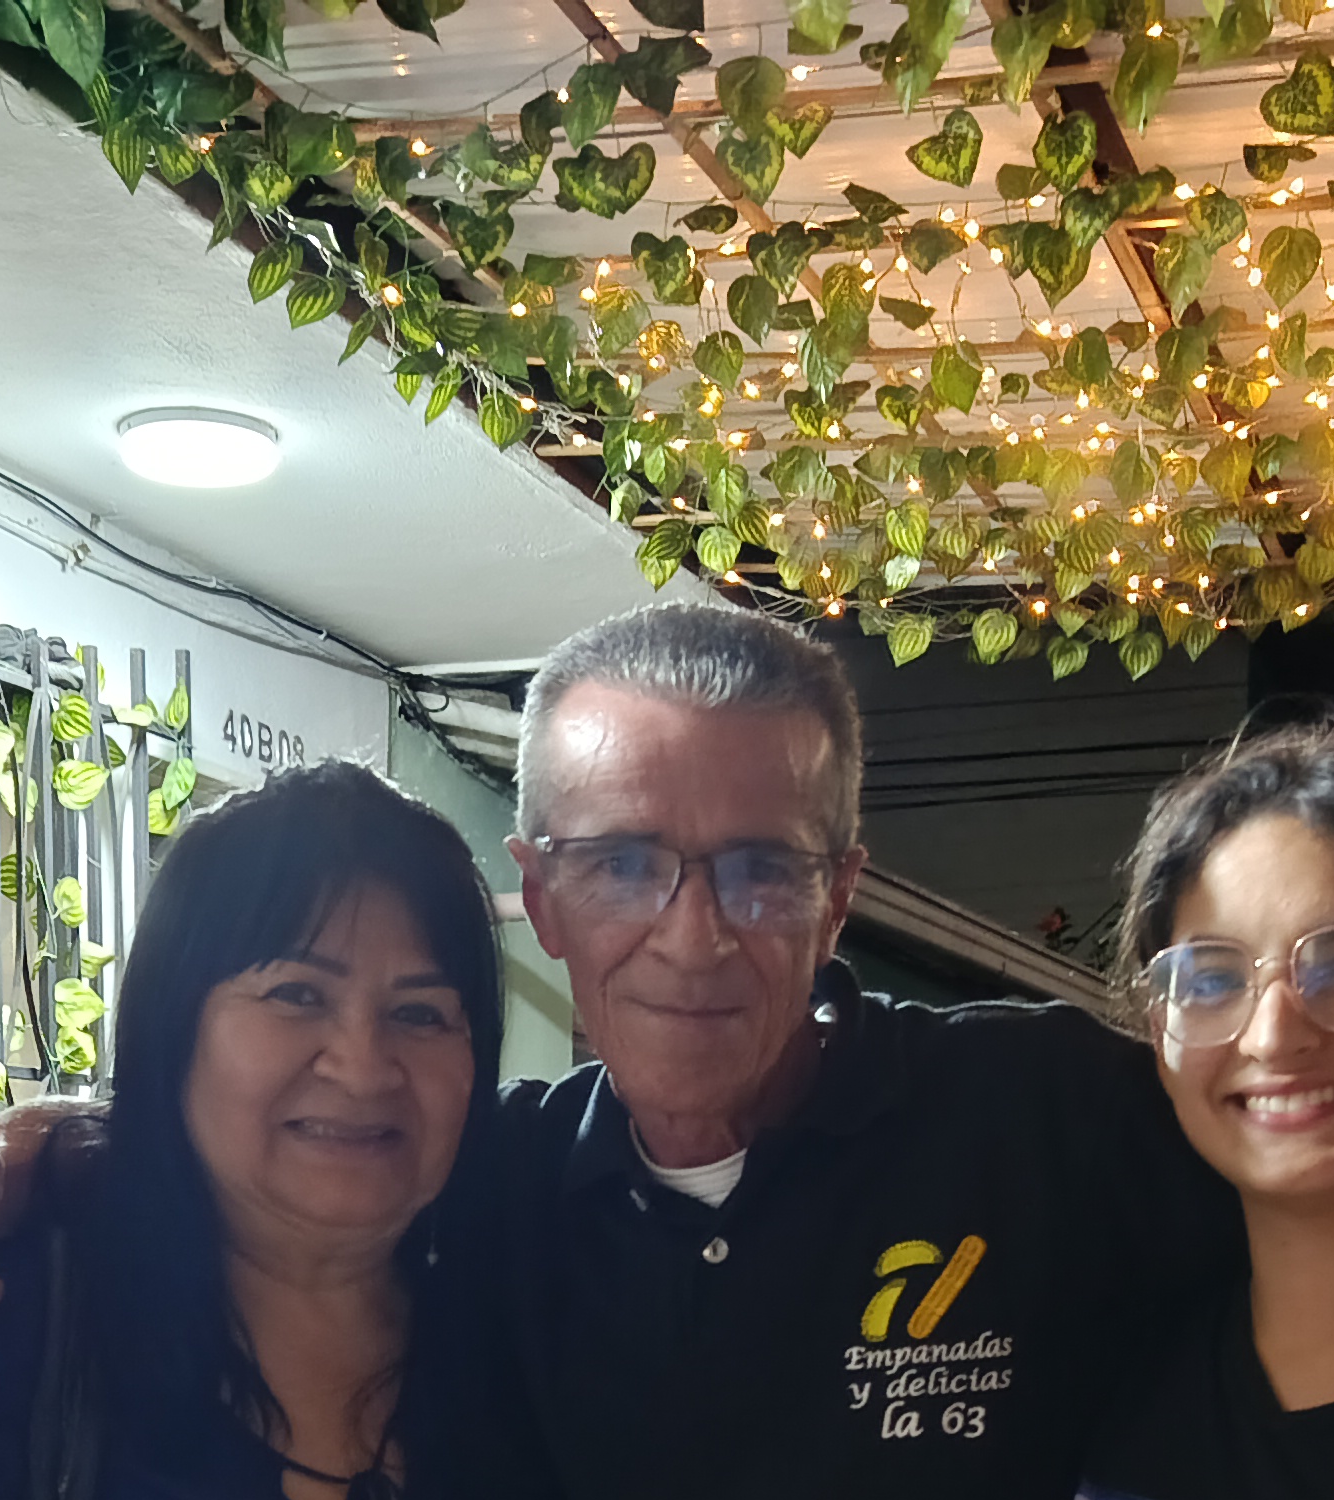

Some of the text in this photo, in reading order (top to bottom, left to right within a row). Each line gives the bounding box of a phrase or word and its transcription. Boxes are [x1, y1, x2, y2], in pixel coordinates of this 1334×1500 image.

[844, 1330, 1013, 1375] Empanadas
[848, 1366, 1013, 1410] y delicias
[880, 1400, 987, 1440] la 63
